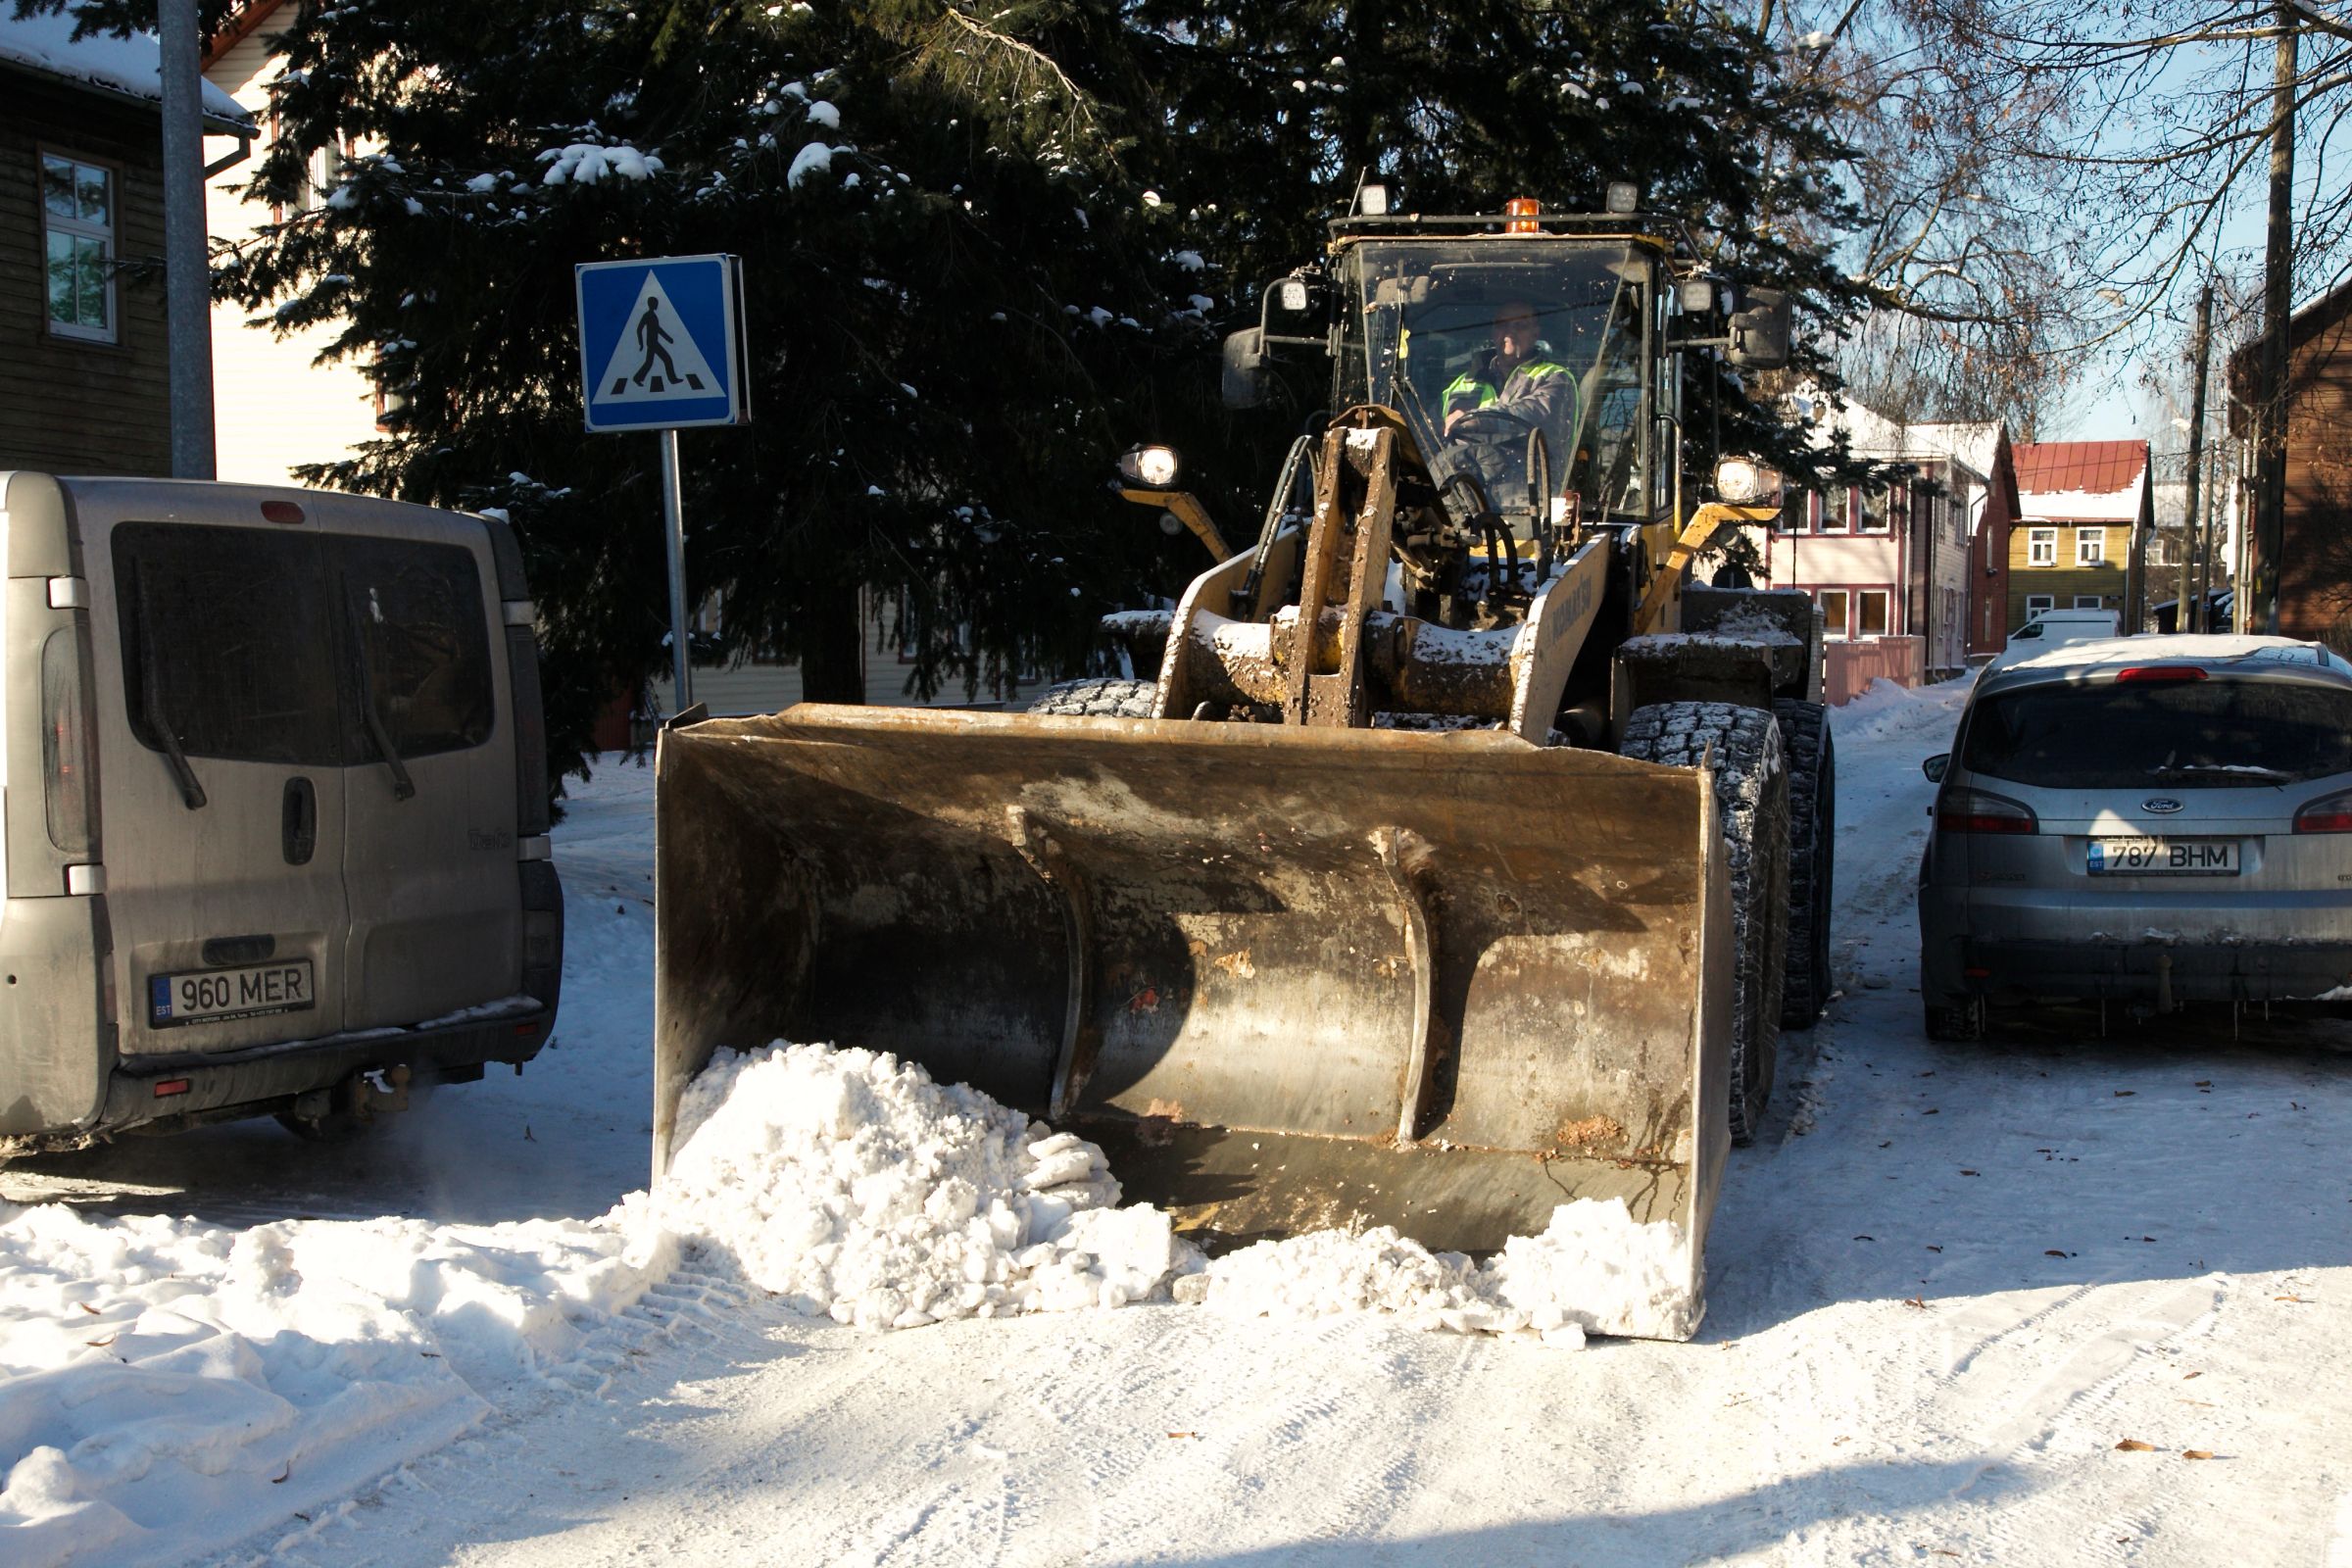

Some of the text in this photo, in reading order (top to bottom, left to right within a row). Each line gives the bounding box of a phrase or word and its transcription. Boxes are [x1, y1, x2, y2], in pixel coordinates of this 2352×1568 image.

[2113, 846, 2228, 867] 787 BHM
[181, 968, 302, 1011] 960 MER
[156, 1004, 171, 1016] EST
